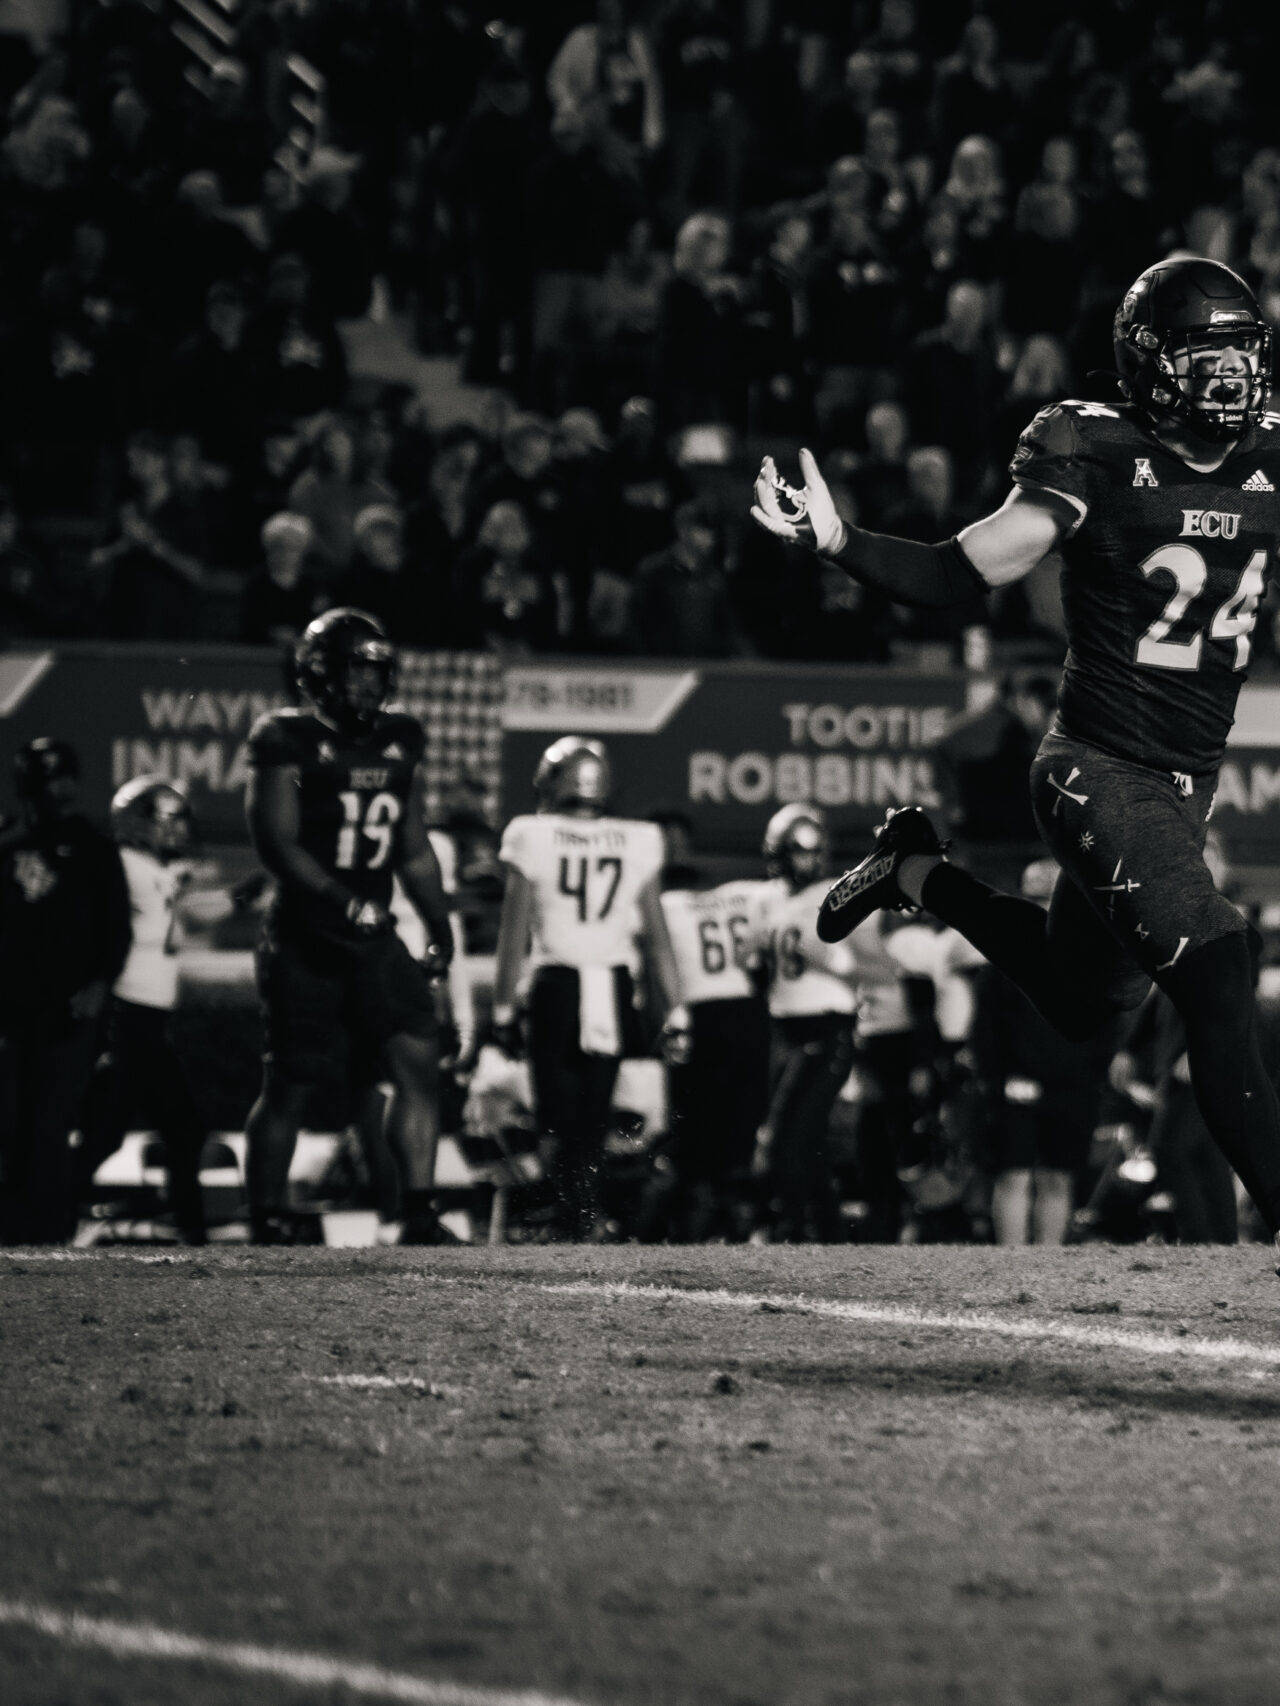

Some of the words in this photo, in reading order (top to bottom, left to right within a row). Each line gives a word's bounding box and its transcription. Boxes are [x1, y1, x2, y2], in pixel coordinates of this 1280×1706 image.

[1241, 483, 1275, 492] adidas
[1178, 509, 1242, 540] ECU
[1133, 542, 1268, 673] 24
[783, 704, 946, 747] TOOTIE
[688, 751, 942, 807] ROBBINS
[336, 790, 401, 869] 19
[559, 857, 622, 921] 47
